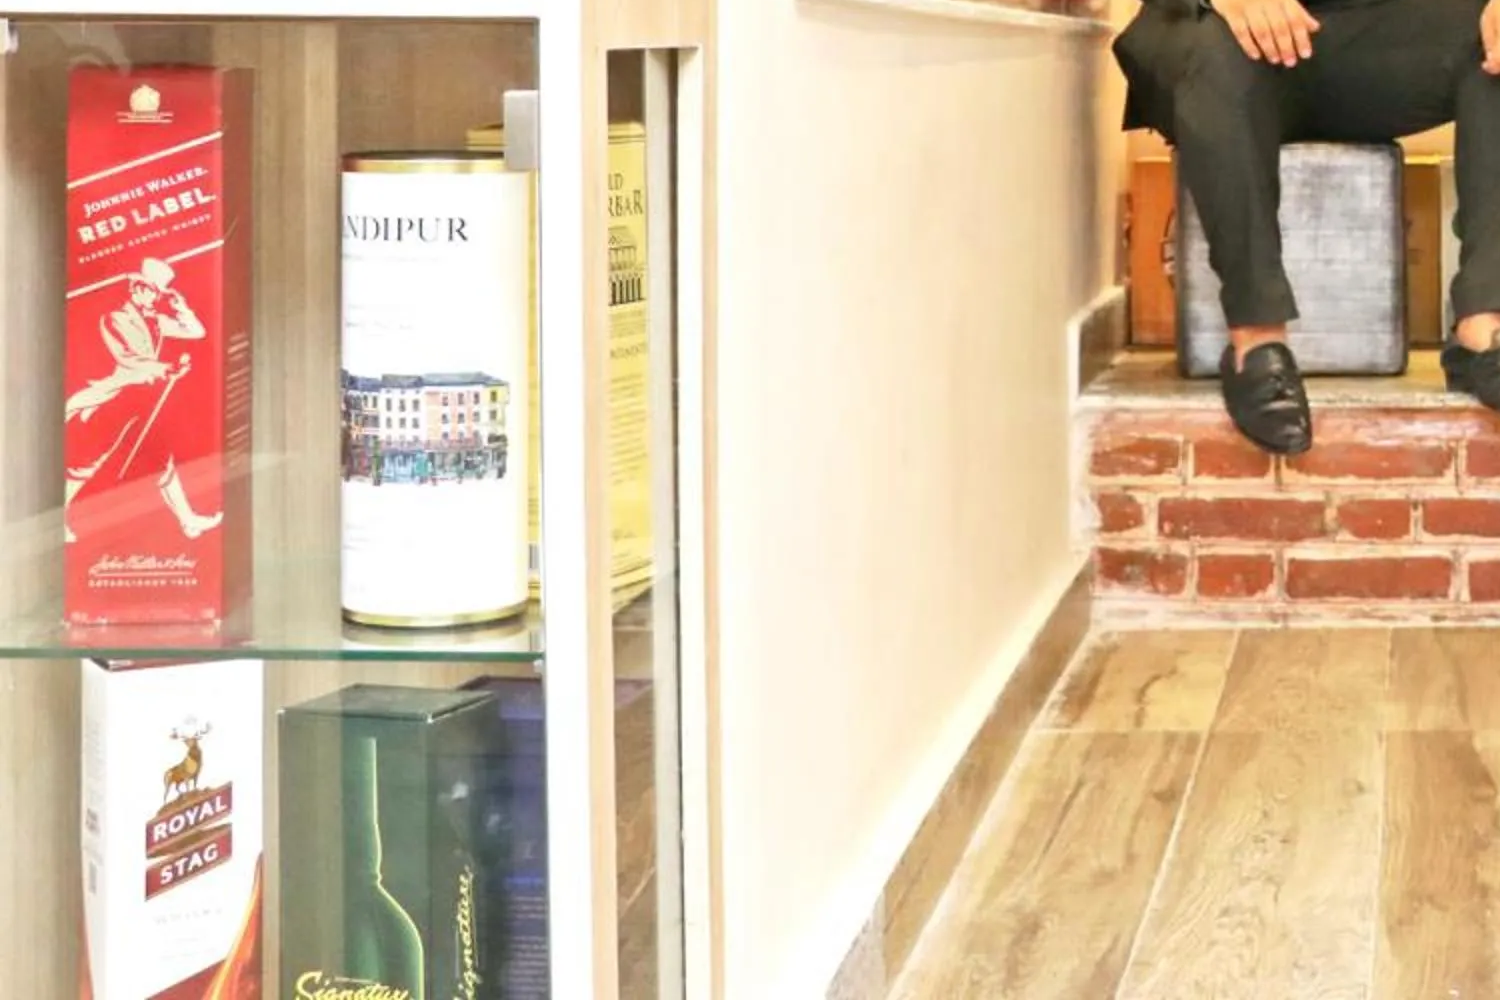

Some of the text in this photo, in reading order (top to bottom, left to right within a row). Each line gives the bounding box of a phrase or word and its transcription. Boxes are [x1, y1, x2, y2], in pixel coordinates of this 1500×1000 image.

[84, 187, 145, 218] JOHNNIE
[78, 215, 127, 244] RED
[153, 796, 227, 843] ROYAL
[160, 843, 219, 884] STAG
